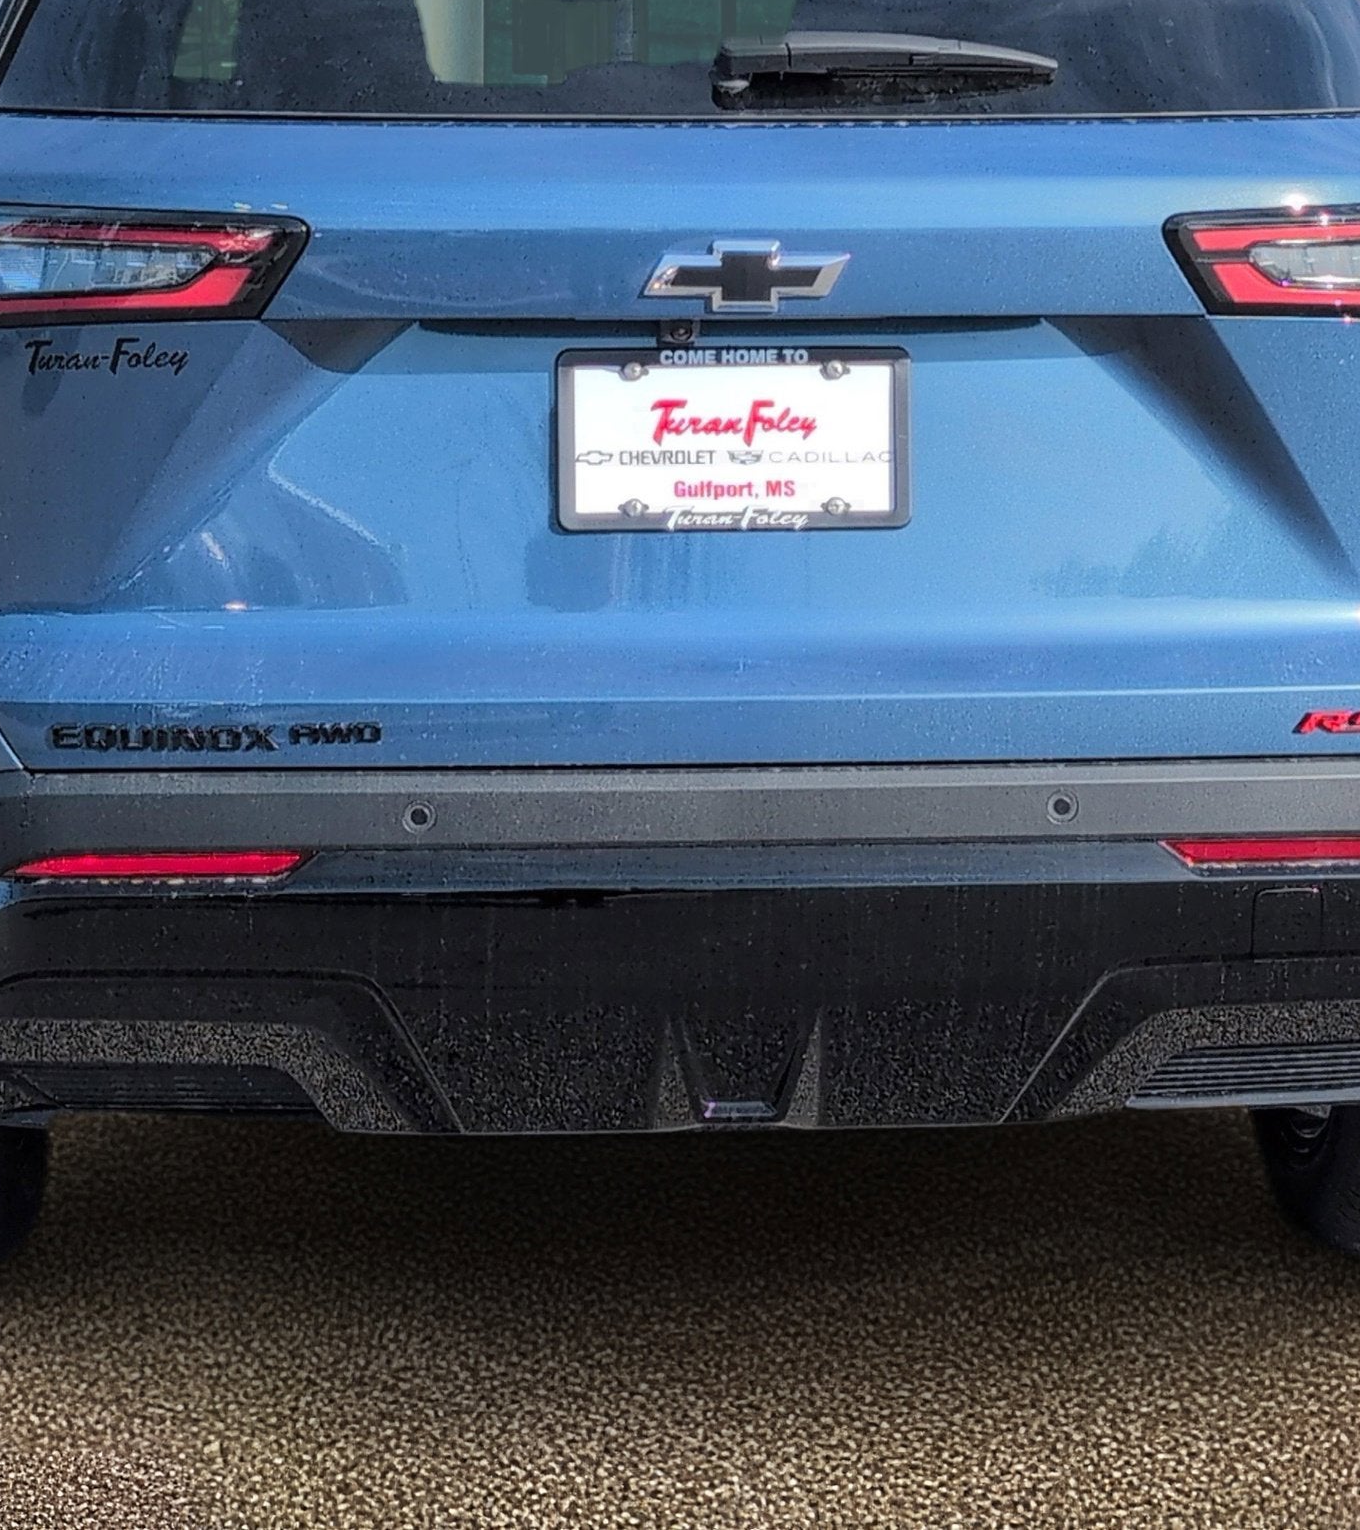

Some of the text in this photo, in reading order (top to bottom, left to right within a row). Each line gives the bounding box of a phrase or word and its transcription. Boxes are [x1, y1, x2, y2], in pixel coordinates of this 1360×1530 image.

[660, 349, 809, 365] COME HOME TO
[650, 399, 817, 447] Turan Foley
[619, 449, 894, 466] CHEVROLET CADILLAC
[673, 480, 796, 501] Gulfport, MS
[50, 721, 382, 751] EQUINOX AWD
